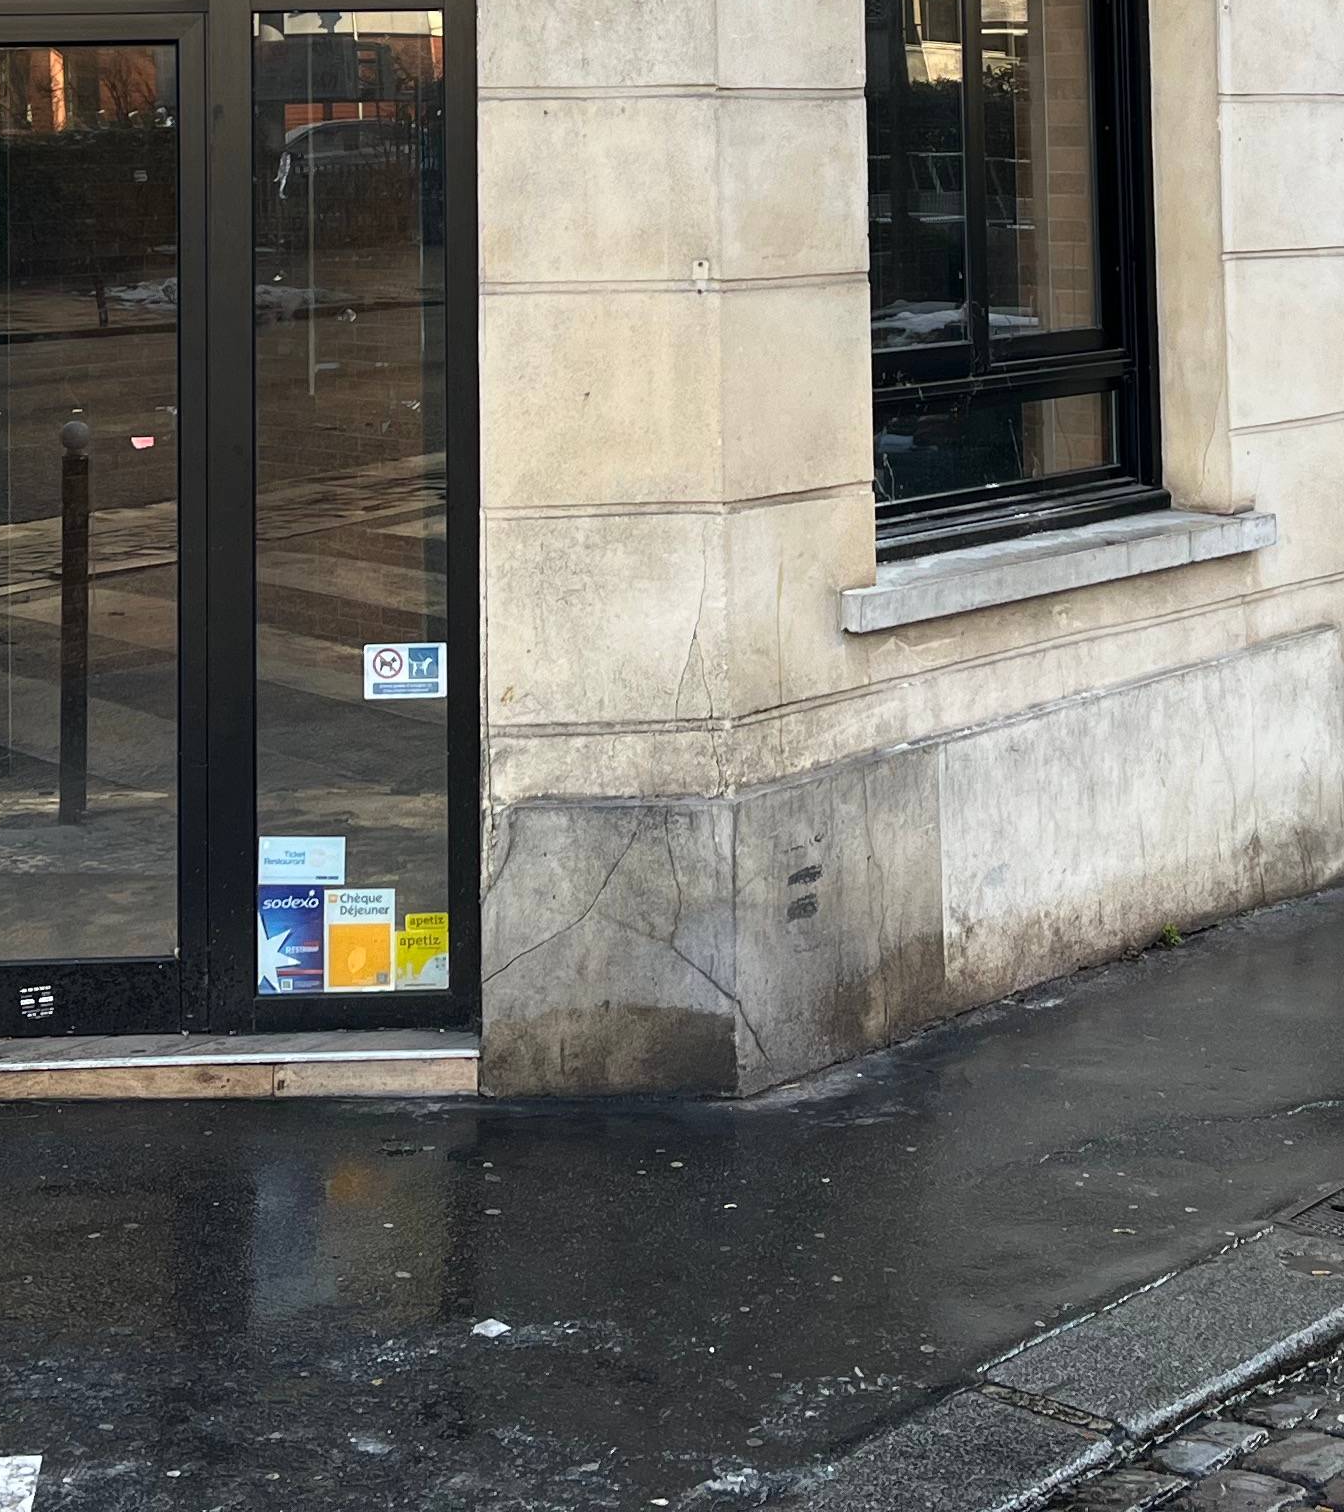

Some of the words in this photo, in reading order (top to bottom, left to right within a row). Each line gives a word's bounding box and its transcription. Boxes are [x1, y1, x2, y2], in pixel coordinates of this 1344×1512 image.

[262, 890, 319, 910] sodexo
[339, 893, 383, 905] Chèque
[339, 905, 390, 917] Déjeuner
[409, 915, 445, 927] apetiz
[399, 934, 441, 948] apetiz
